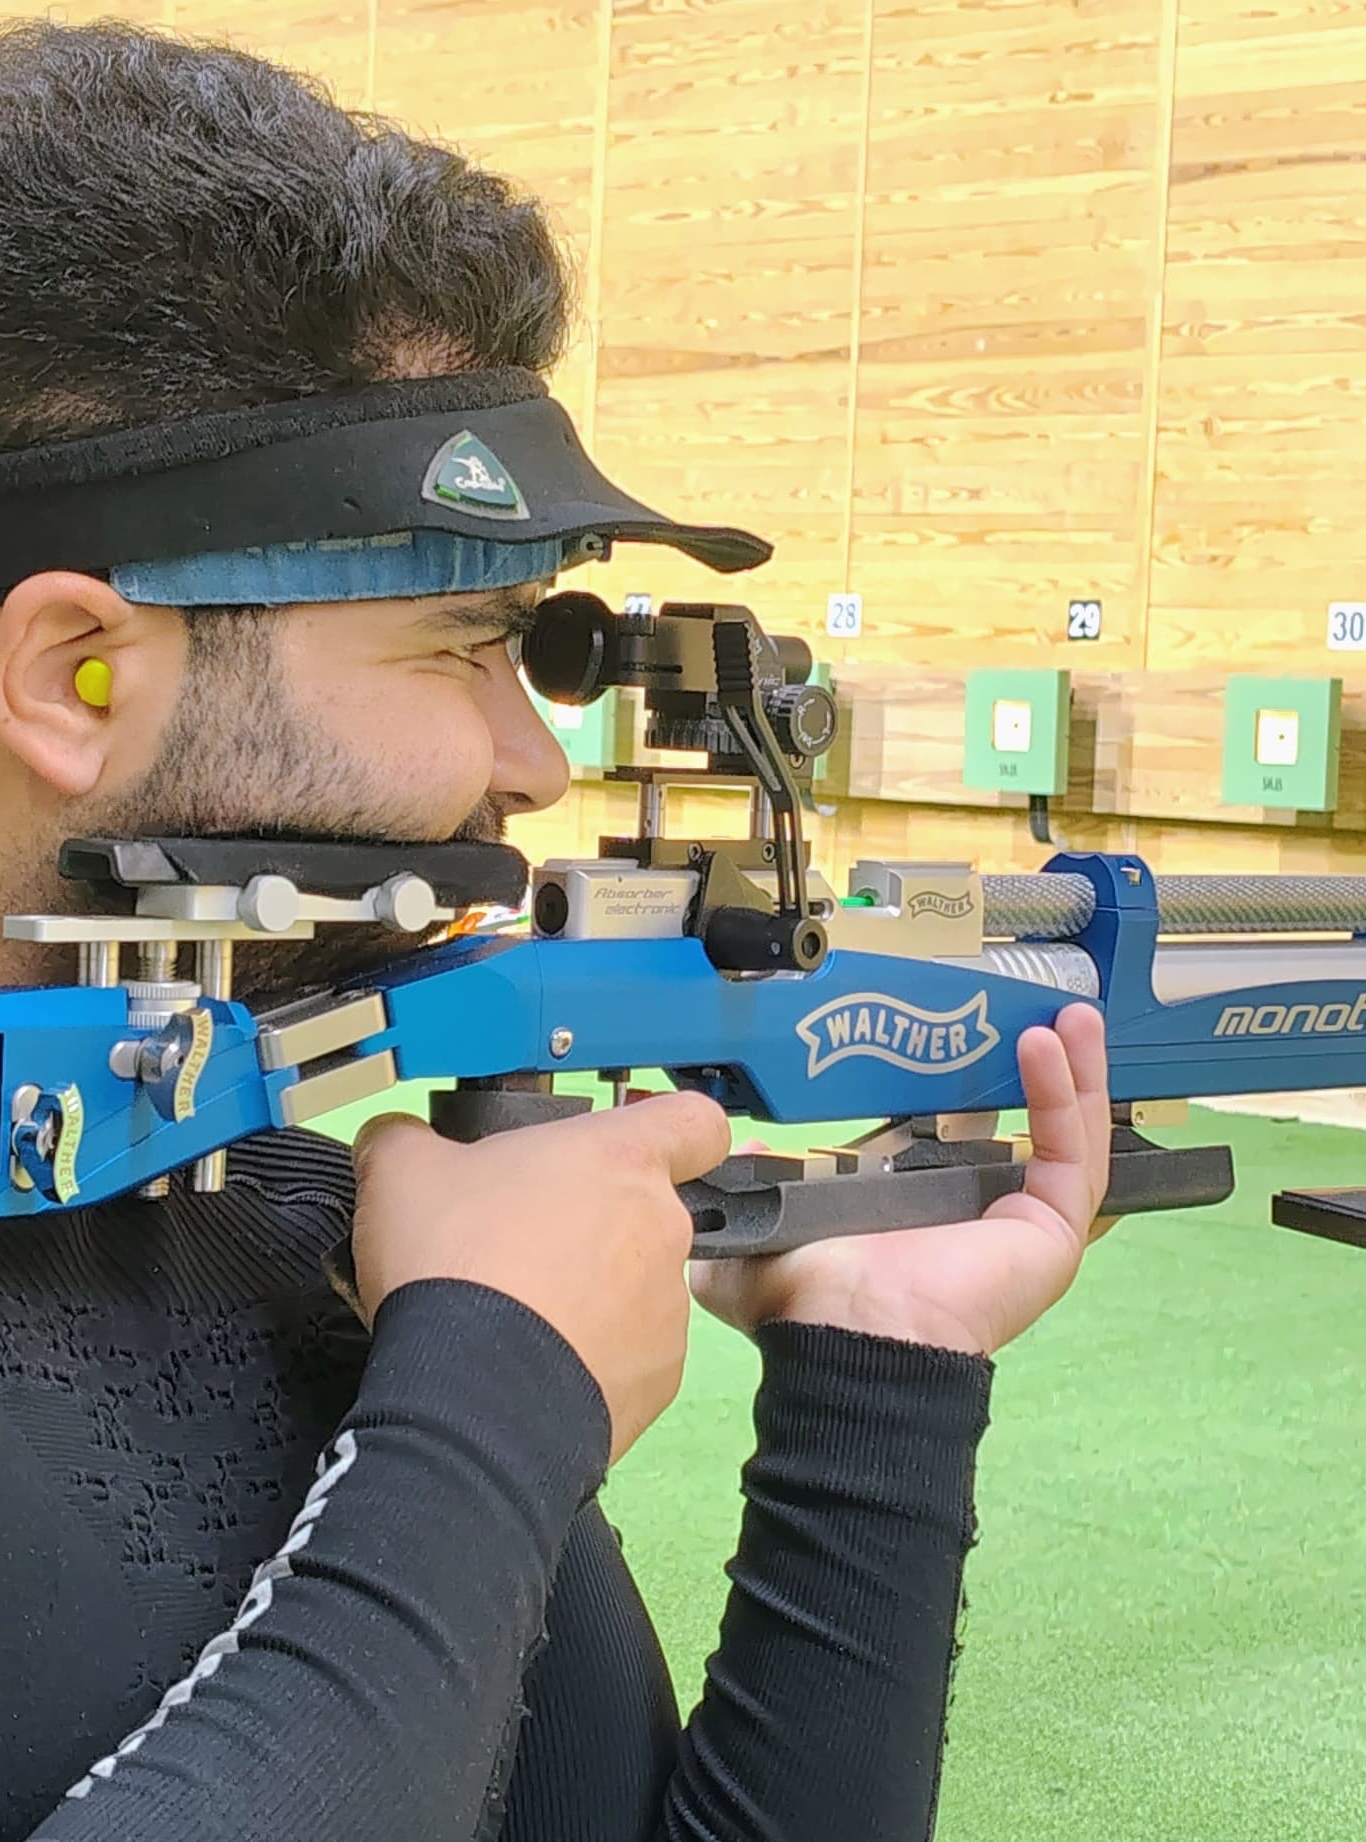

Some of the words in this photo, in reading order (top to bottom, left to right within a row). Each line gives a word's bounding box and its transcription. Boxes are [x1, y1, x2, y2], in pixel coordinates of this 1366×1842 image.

[832, 602, 857, 629] 28
[1068, 602, 1100, 638] 29
[1332, 611, 1365, 642] 30
[594, 887, 673, 900] Absorber
[604, 902, 682, 916] electronic
[916, 895, 965, 915] WALTHER
[825, 1007, 969, 1061] WALTHER
[178, 1014, 209, 1113] WALTHER
[60, 1090, 81, 1193] WALTHER
